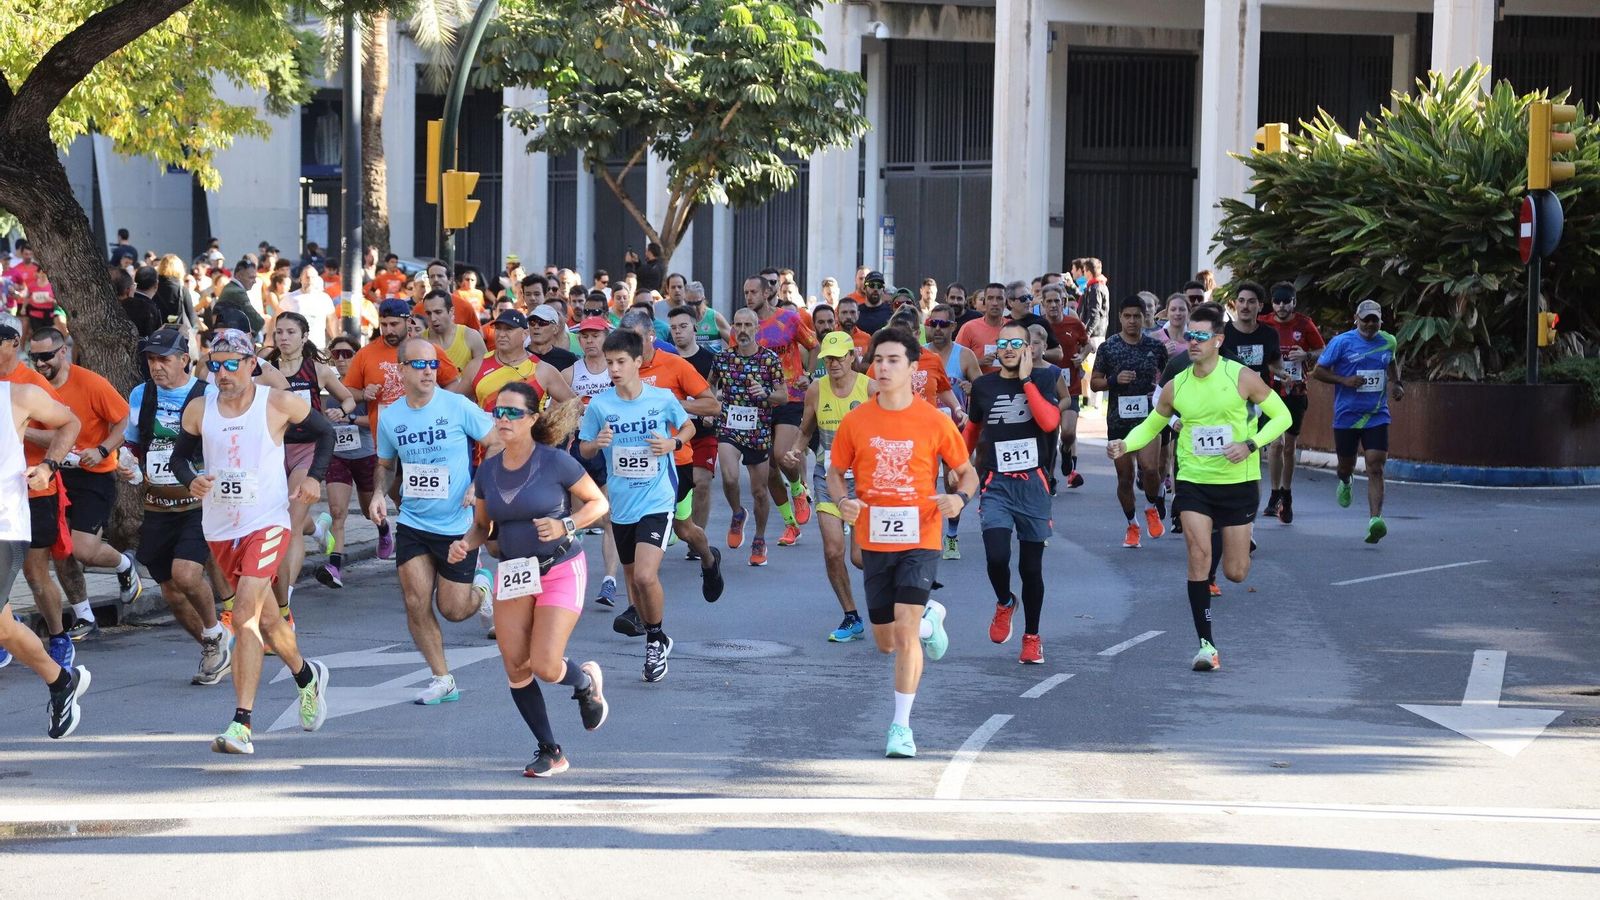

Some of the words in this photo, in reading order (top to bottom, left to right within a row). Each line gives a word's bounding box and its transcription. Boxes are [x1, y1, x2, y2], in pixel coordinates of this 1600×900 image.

[1125, 404, 1139, 412] 44
[731, 413, 755, 422] 1012
[609, 417, 658, 434] nerja
[397, 426, 447, 446] nerja
[1197, 436, 1224, 447] 111
[406, 446, 442, 456] ATLETISMO
[1002, 450, 1029, 462] 811
[619, 457, 649, 468] 925
[409, 475, 440, 487] 926
[221, 481, 242, 494] 35
[882, 520, 904, 532] 72
[503, 571, 531, 588] 242
